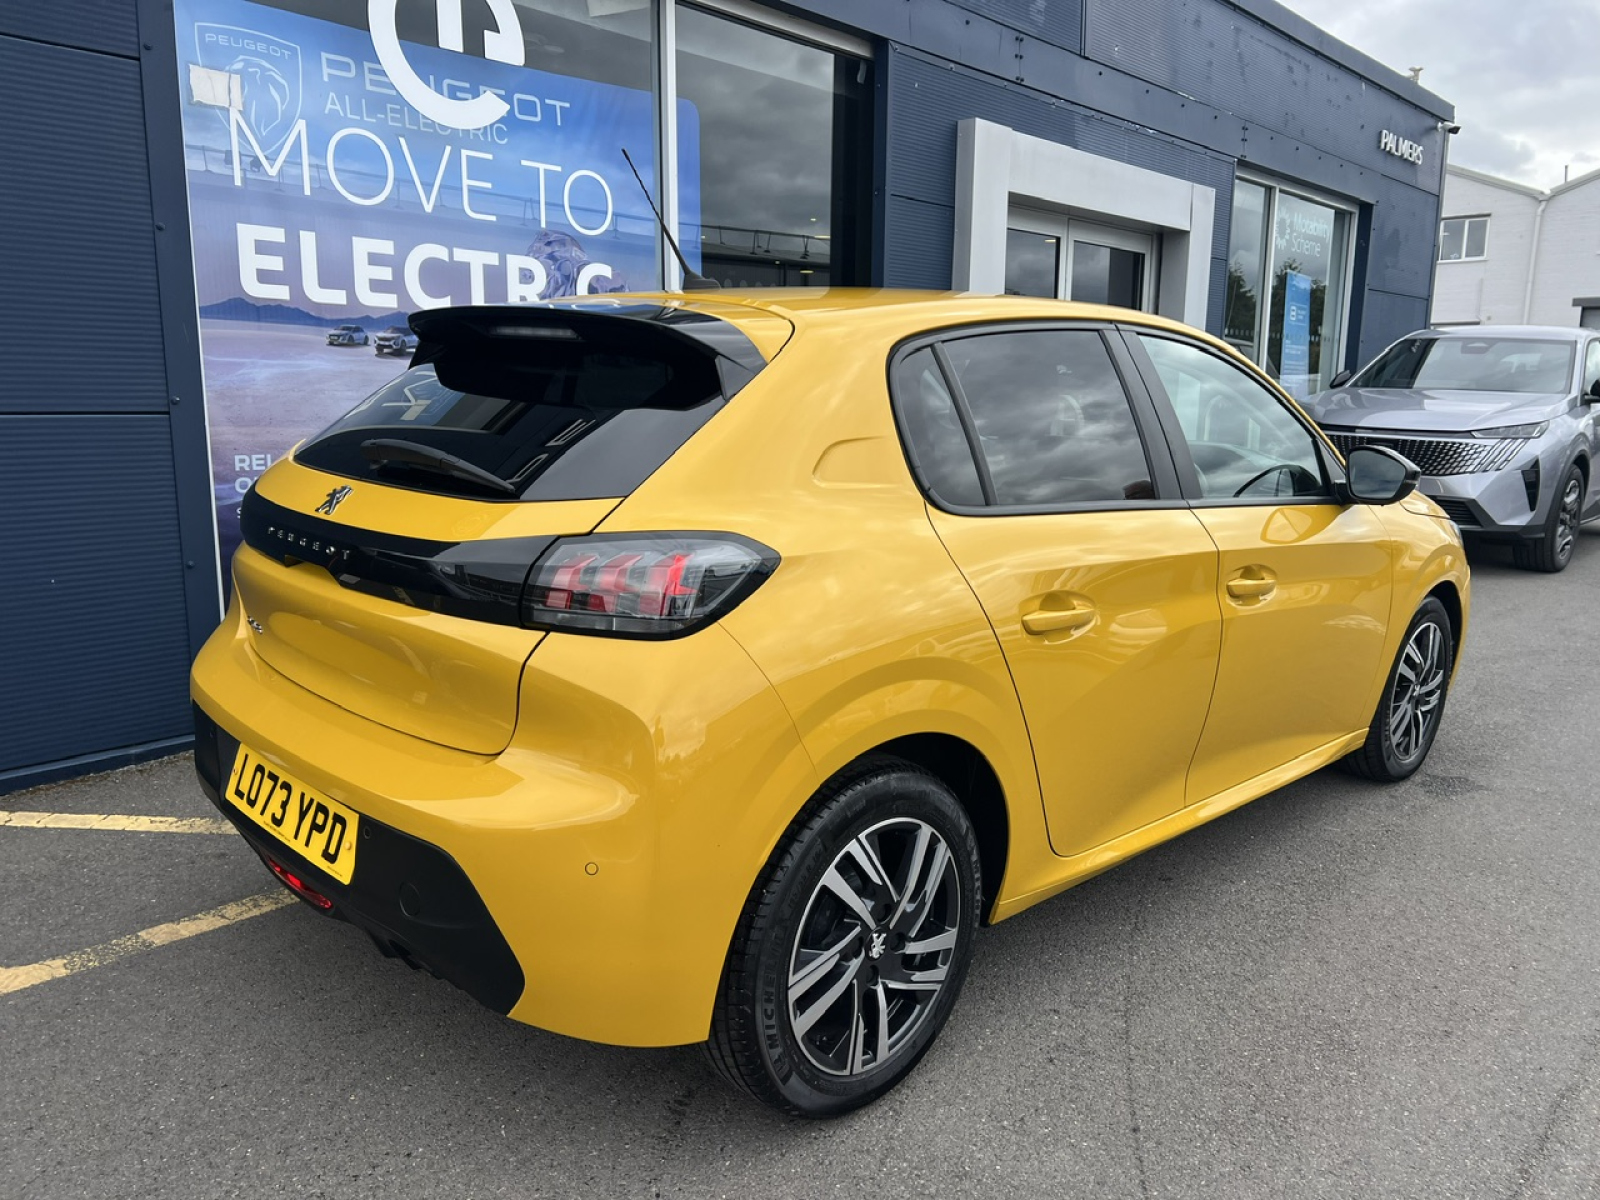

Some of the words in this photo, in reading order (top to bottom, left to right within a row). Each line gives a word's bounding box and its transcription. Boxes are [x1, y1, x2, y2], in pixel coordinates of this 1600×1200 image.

[205, 33, 291, 60] PEUGEOT
[320, 51, 571, 126] PEGOT
[229, 107, 497, 222] MOVE
[520, 159, 614, 236] TO
[1380, 129, 1425, 165] PALMERS
[236, 222, 612, 310] ELECTRC
[268, 526, 350, 560] PEUGEOT
[293, 791, 347, 865] YPD
